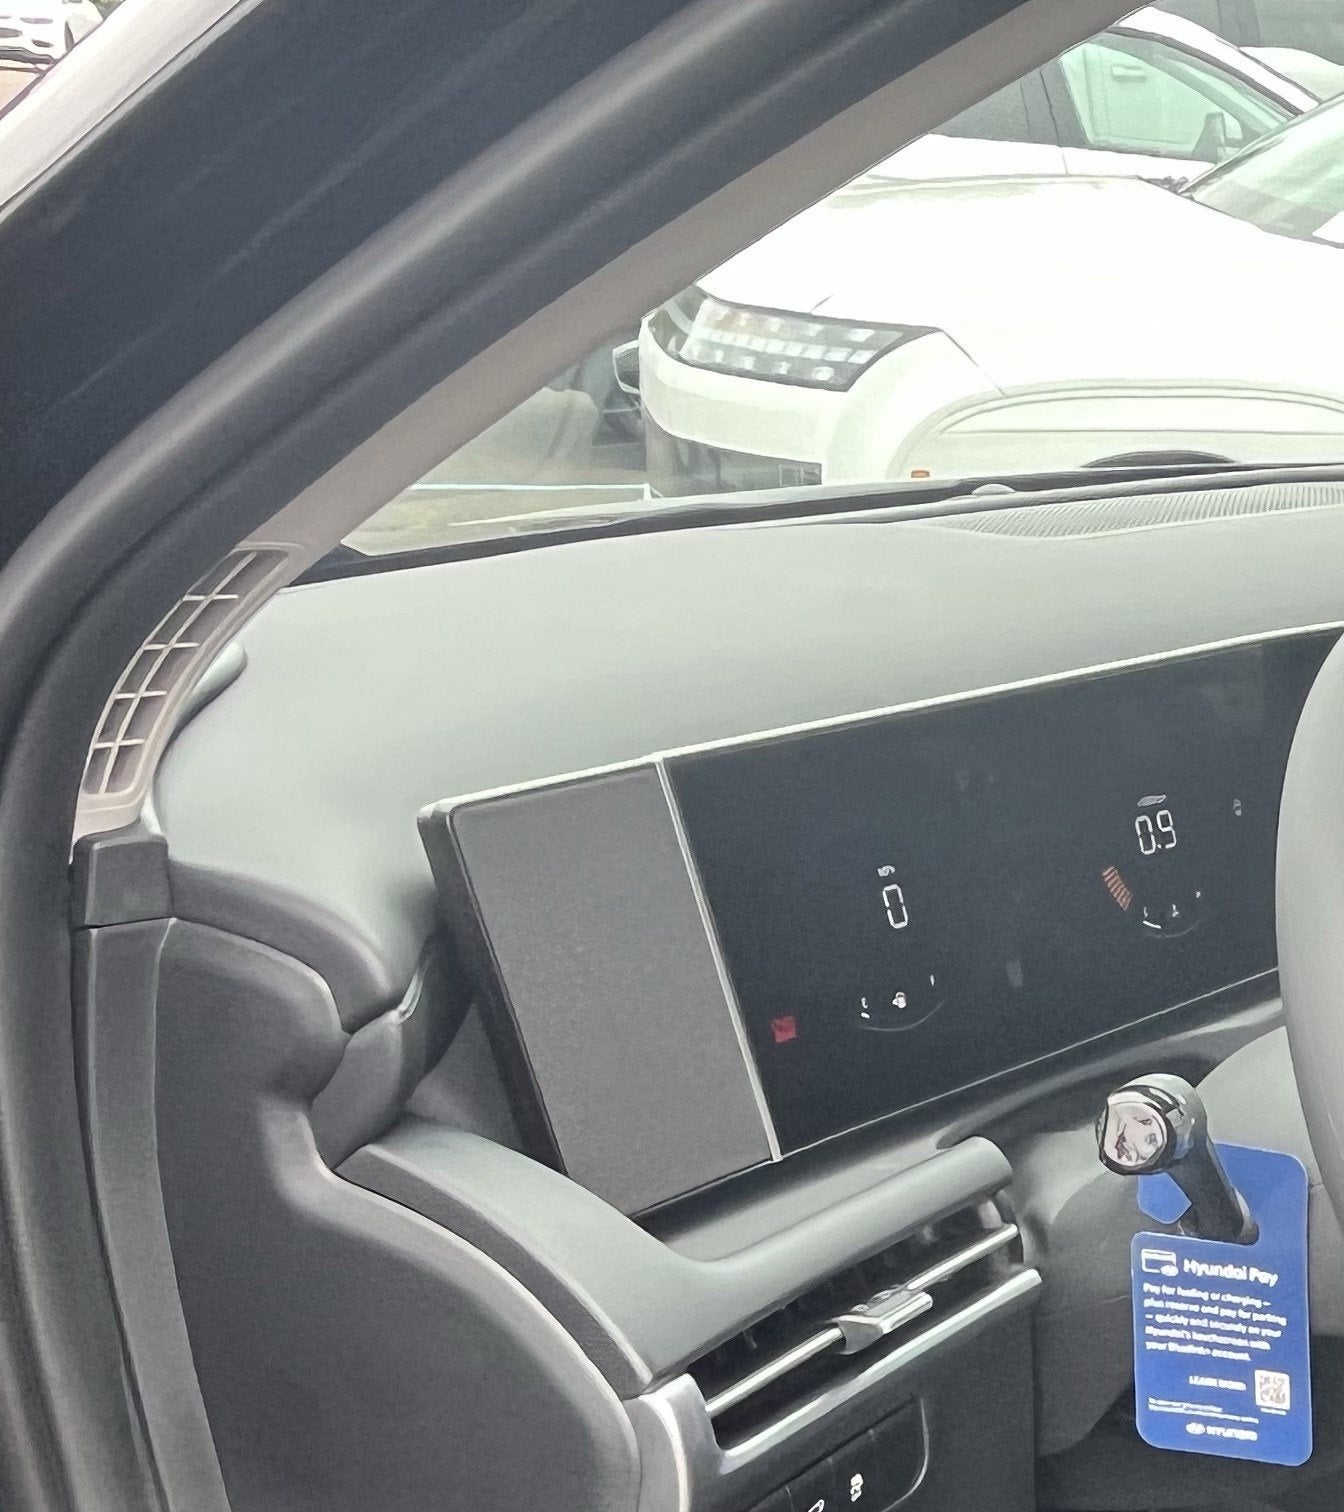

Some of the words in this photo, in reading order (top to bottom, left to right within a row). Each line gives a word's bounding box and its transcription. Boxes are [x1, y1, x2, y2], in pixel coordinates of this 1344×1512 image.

[1135, 809, 1177, 855] 0.9
[1183, 1258, 1248, 1281] Hyundai
[1248, 1266, 1279, 1287] Pay
[1143, 1282, 1161, 1295] Pay
